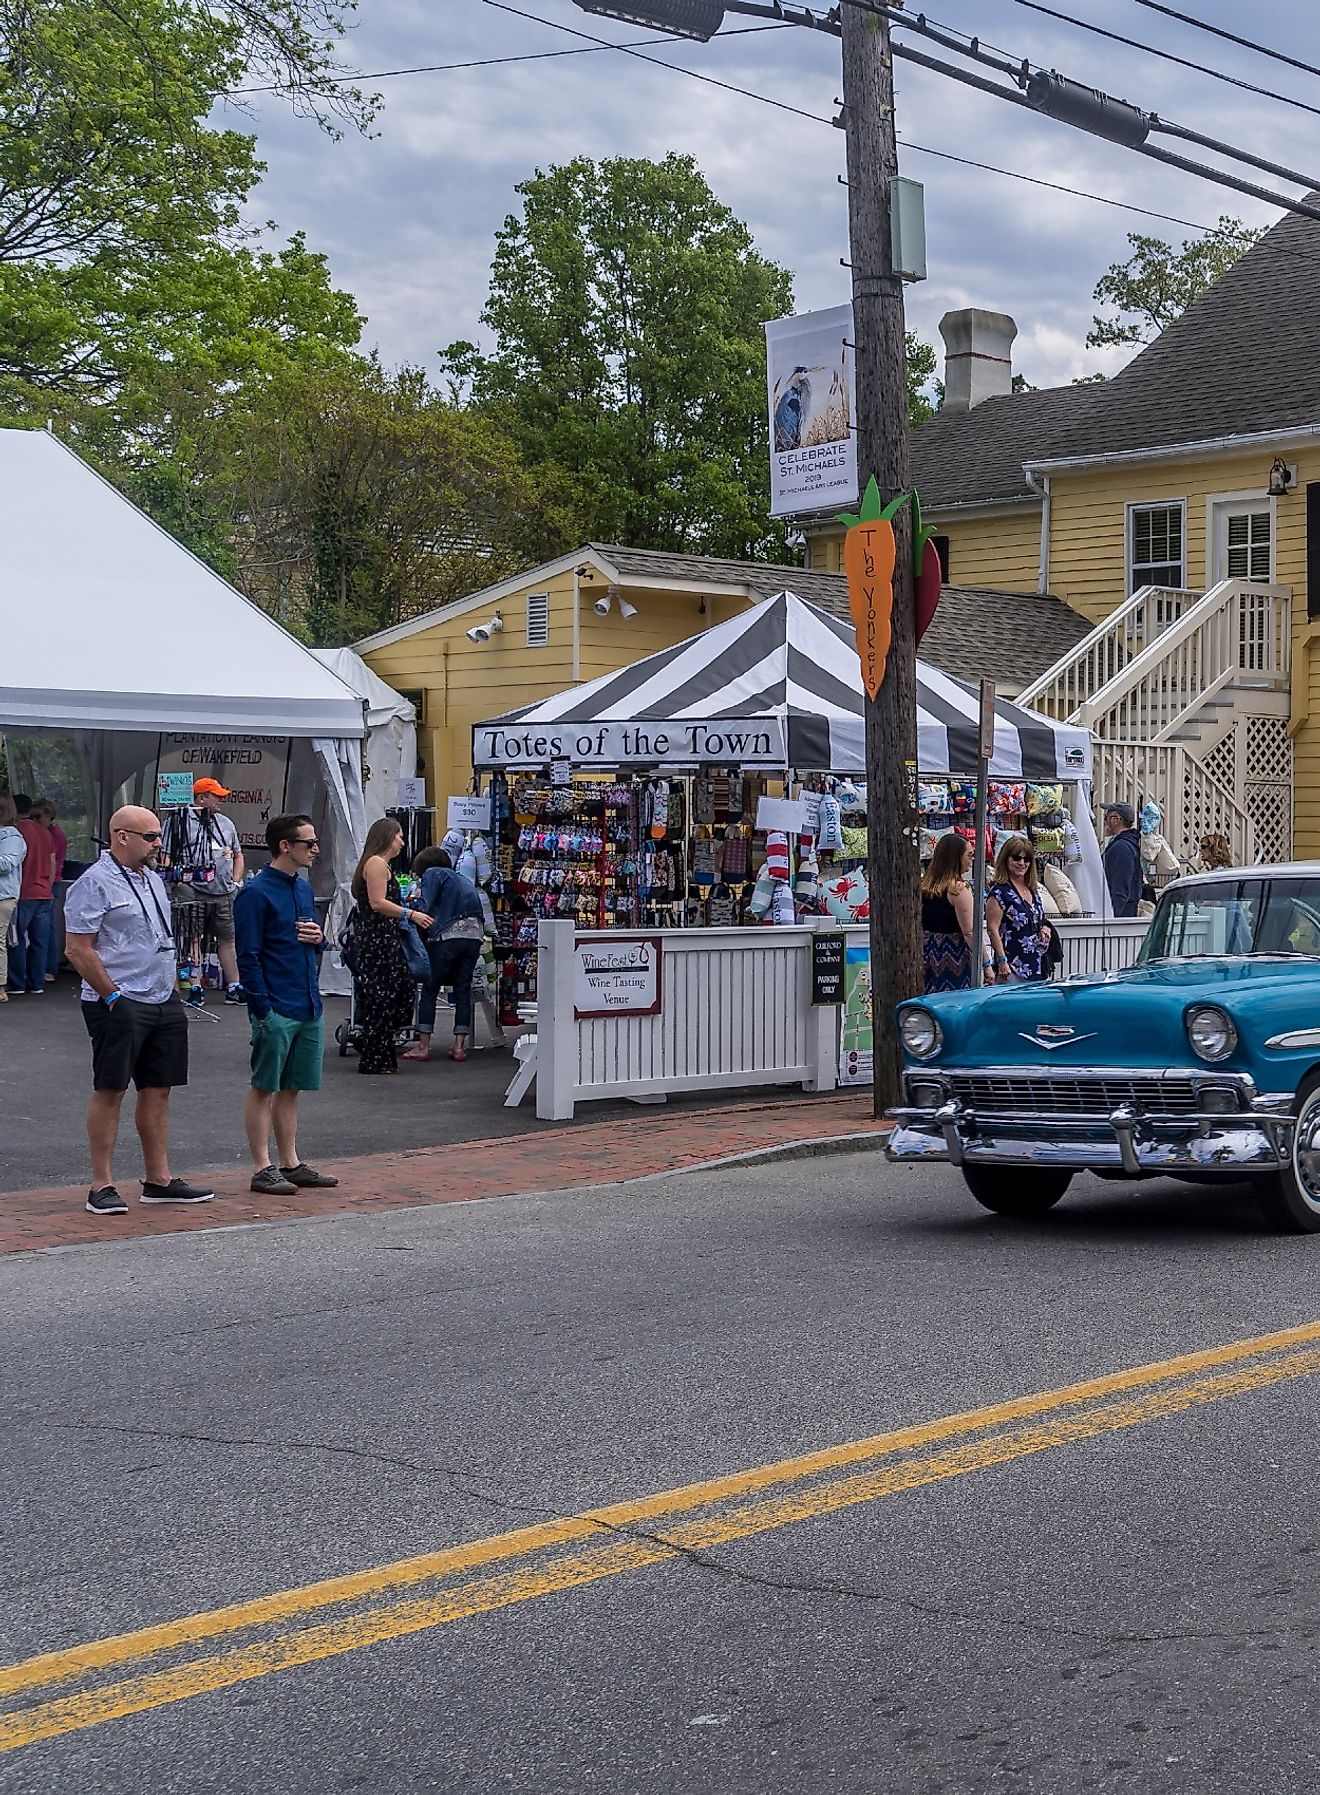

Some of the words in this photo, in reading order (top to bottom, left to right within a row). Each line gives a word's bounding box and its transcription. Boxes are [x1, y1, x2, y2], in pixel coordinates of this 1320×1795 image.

[778, 444, 846, 465] CELEBRATE
[796, 457, 846, 475] MICHAELS
[860, 529, 877, 578] The
[862, 586, 877, 690] Yonkers
[484, 730, 562, 758] Totes
[576, 727, 609, 756] of
[622, 727, 670, 755] the
[685, 725, 773, 755] Town
[825, 801, 838, 843] Easton
[587, 977, 611, 988] Wine
[612, 975, 646, 989] Tasting
[603, 993, 630, 1005] Venue
